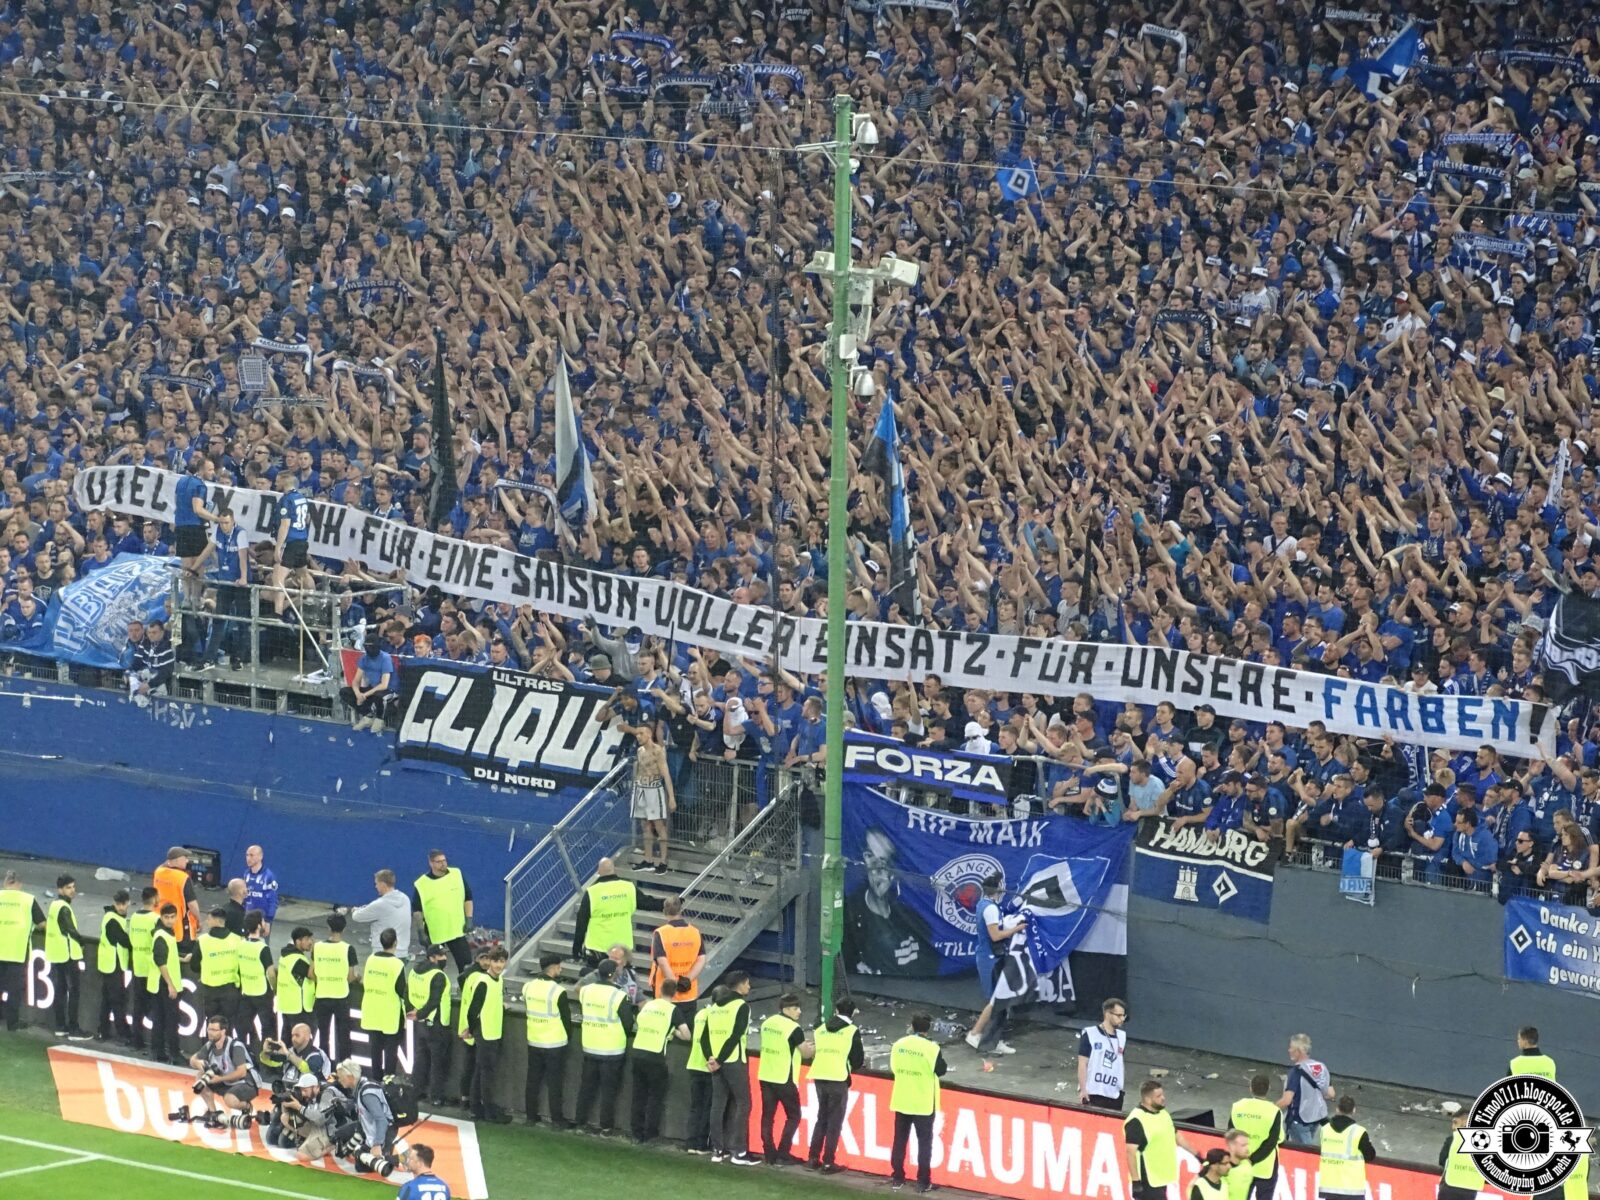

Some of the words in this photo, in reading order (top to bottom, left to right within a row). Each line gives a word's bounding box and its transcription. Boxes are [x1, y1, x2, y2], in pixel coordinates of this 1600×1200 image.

[86, 465, 234, 526] VIELN
[255, 494, 347, 547] DNK
[359, 516, 418, 571] FÜR
[426, 540, 499, 590] EINE
[511, 556, 640, 621] SAISON
[654, 585, 796, 657] VOLLER
[1010, 637, 1099, 685] FÜR
[1120, 646, 1297, 713] UNSERE
[492, 670, 565, 692] ULTRAS
[473, 767, 500, 781] DU
[504, 774, 556, 790] NORD
[844, 745, 1004, 791] FORZA
[907, 808, 956, 836] RIP
[968, 821, 1049, 848] MAIK
[1149, 821, 1270, 867] HAMBURG
[944, 862, 993, 882] RANGE
[1540, 906, 1588, 935] Danke
[1536, 931, 1557, 953] ich
[1562, 940, 1588, 960] ein
